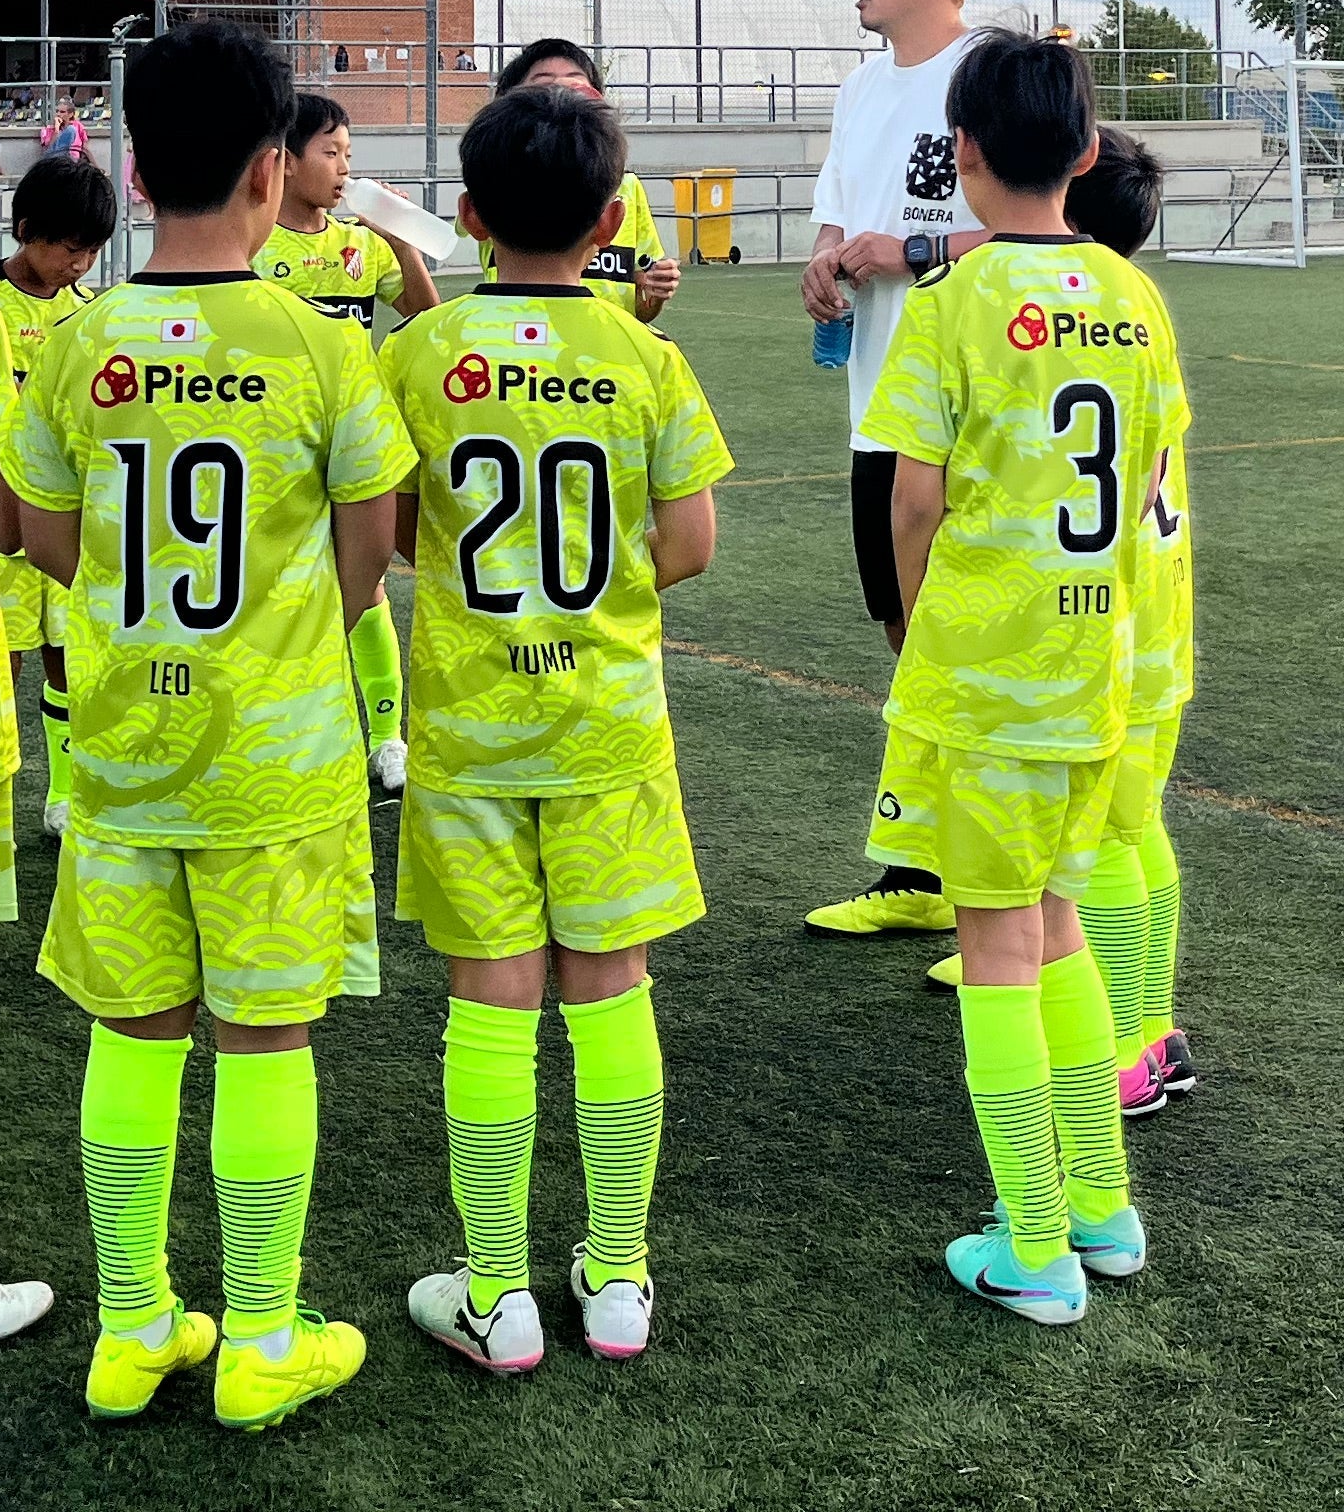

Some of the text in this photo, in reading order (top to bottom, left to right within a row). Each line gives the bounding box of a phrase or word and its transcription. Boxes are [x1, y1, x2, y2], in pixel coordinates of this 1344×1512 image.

[902, 206, 954, 224] BONERA
[1053, 312, 1149, 348] Piece
[144, 364, 267, 404] Piece
[498, 364, 617, 405] Piece
[1053, 382, 1119, 554] 3
[106, 442, 245, 630] 19
[450, 438, 611, 614] 20
[1059, 584, 1110, 616] EITO
[506, 640, 576, 676] YUMA
[150, 661, 190, 696] LEO
